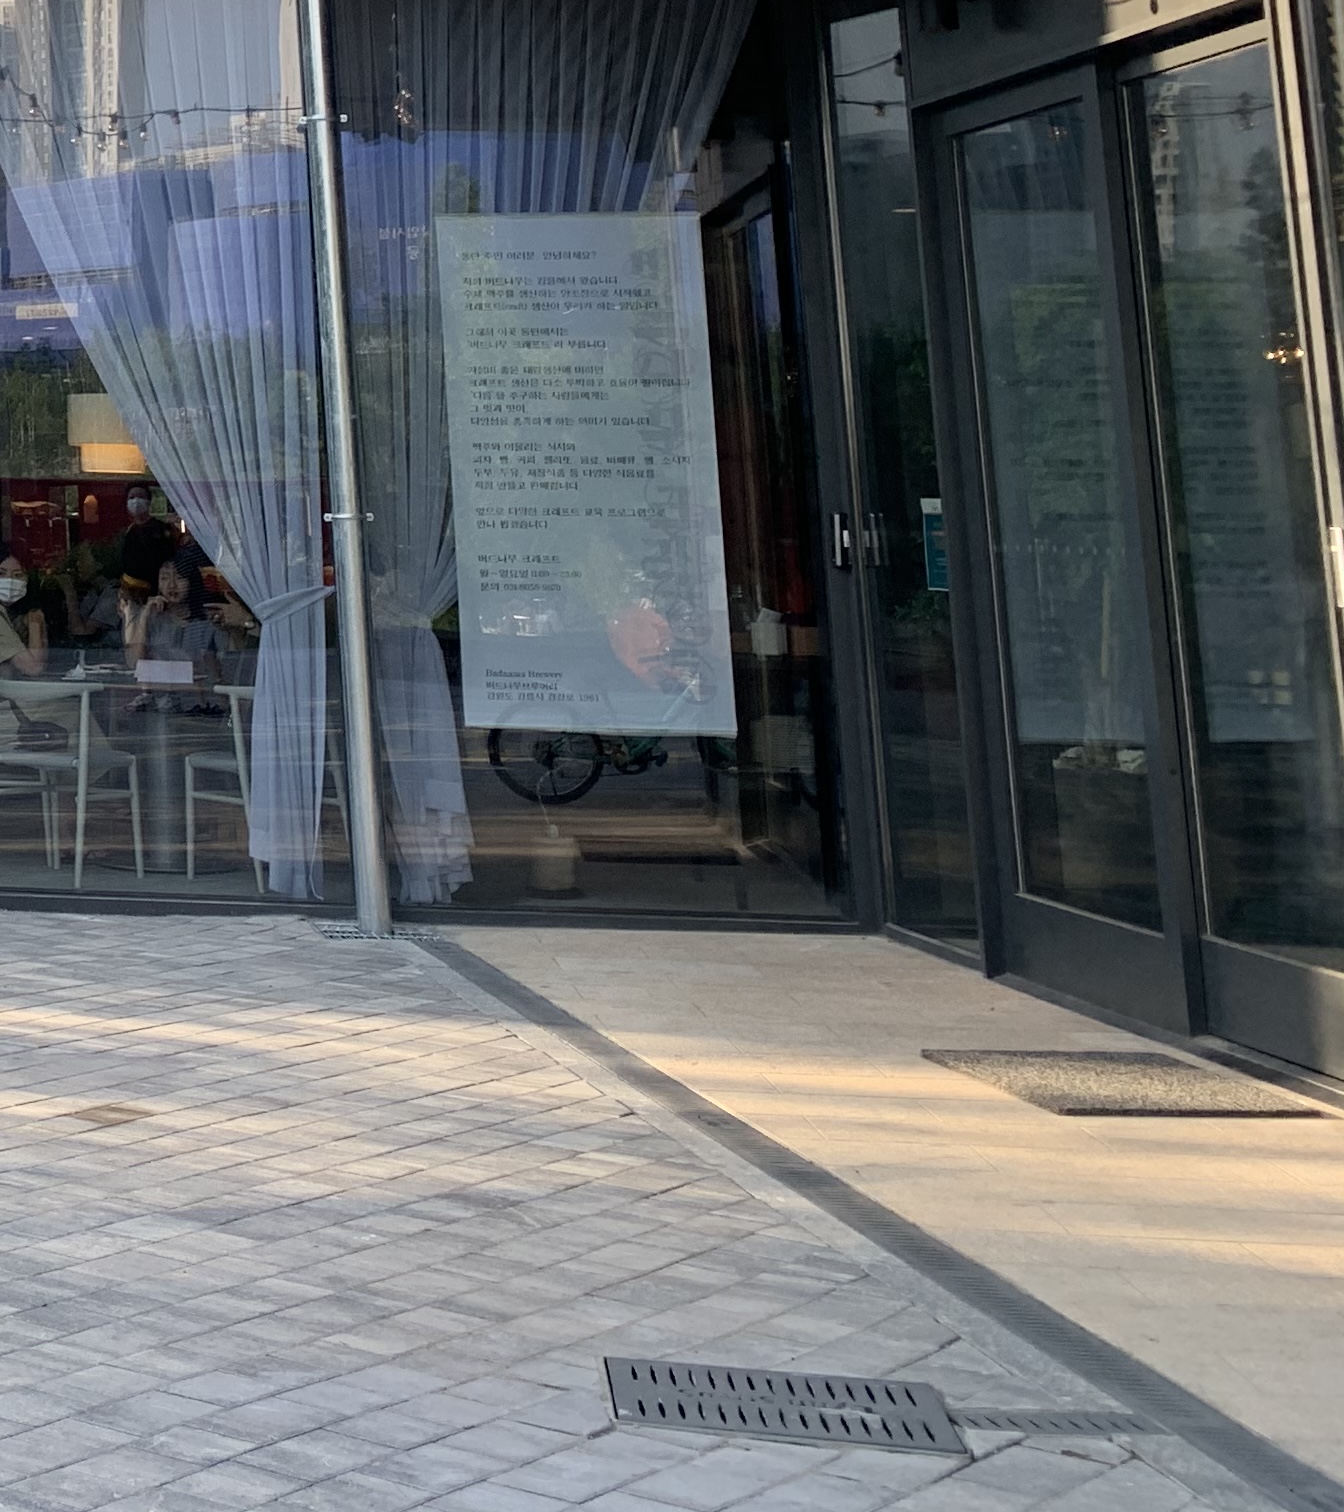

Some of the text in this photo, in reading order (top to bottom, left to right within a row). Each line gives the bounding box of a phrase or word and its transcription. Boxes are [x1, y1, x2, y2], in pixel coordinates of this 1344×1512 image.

[542, 251, 597, 261] 안녕하세요?
[485, 276, 533, 287] 버드나무는
[486, 289, 515, 299] 맥주를
[519, 289, 557, 299] 생산하는
[560, 289, 609, 299] 양조장으로
[531, 302, 559, 312] 생산이
[596, 302, 615, 312] 하는
[465, 328, 569, 337] 그래서 이곳 동탄에서는
[501, 366, 519, 375] 좋은
[468, 378, 507, 388] 크래프트
[511, 378, 540, 388] 생산은
[542, 378, 562, 388] 다소
[509, 391, 548, 401] 추구하는
[551, 391, 610, 401] 사람들에게는
[469, 403, 479, 413] 그
[555, 416, 574, 427] 하는
[472, 442, 576, 452] 맥주와 어울리는 식사와
[569, 468, 579, 479] 등
[582, 468, 612, 479] 다양한
[616, 468, 655, 479] 식음료를
[497, 481, 526, 491] 만들고
[475, 507, 504, 517] 앞으로
[508, 507, 537, 517] 다양한
[541, 507, 580, 517] 크래프트
[476, 520, 495, 530] 만나
[477, 554, 561, 564] 버드나무 크래프트
[528, 669, 563, 678] Brewery
